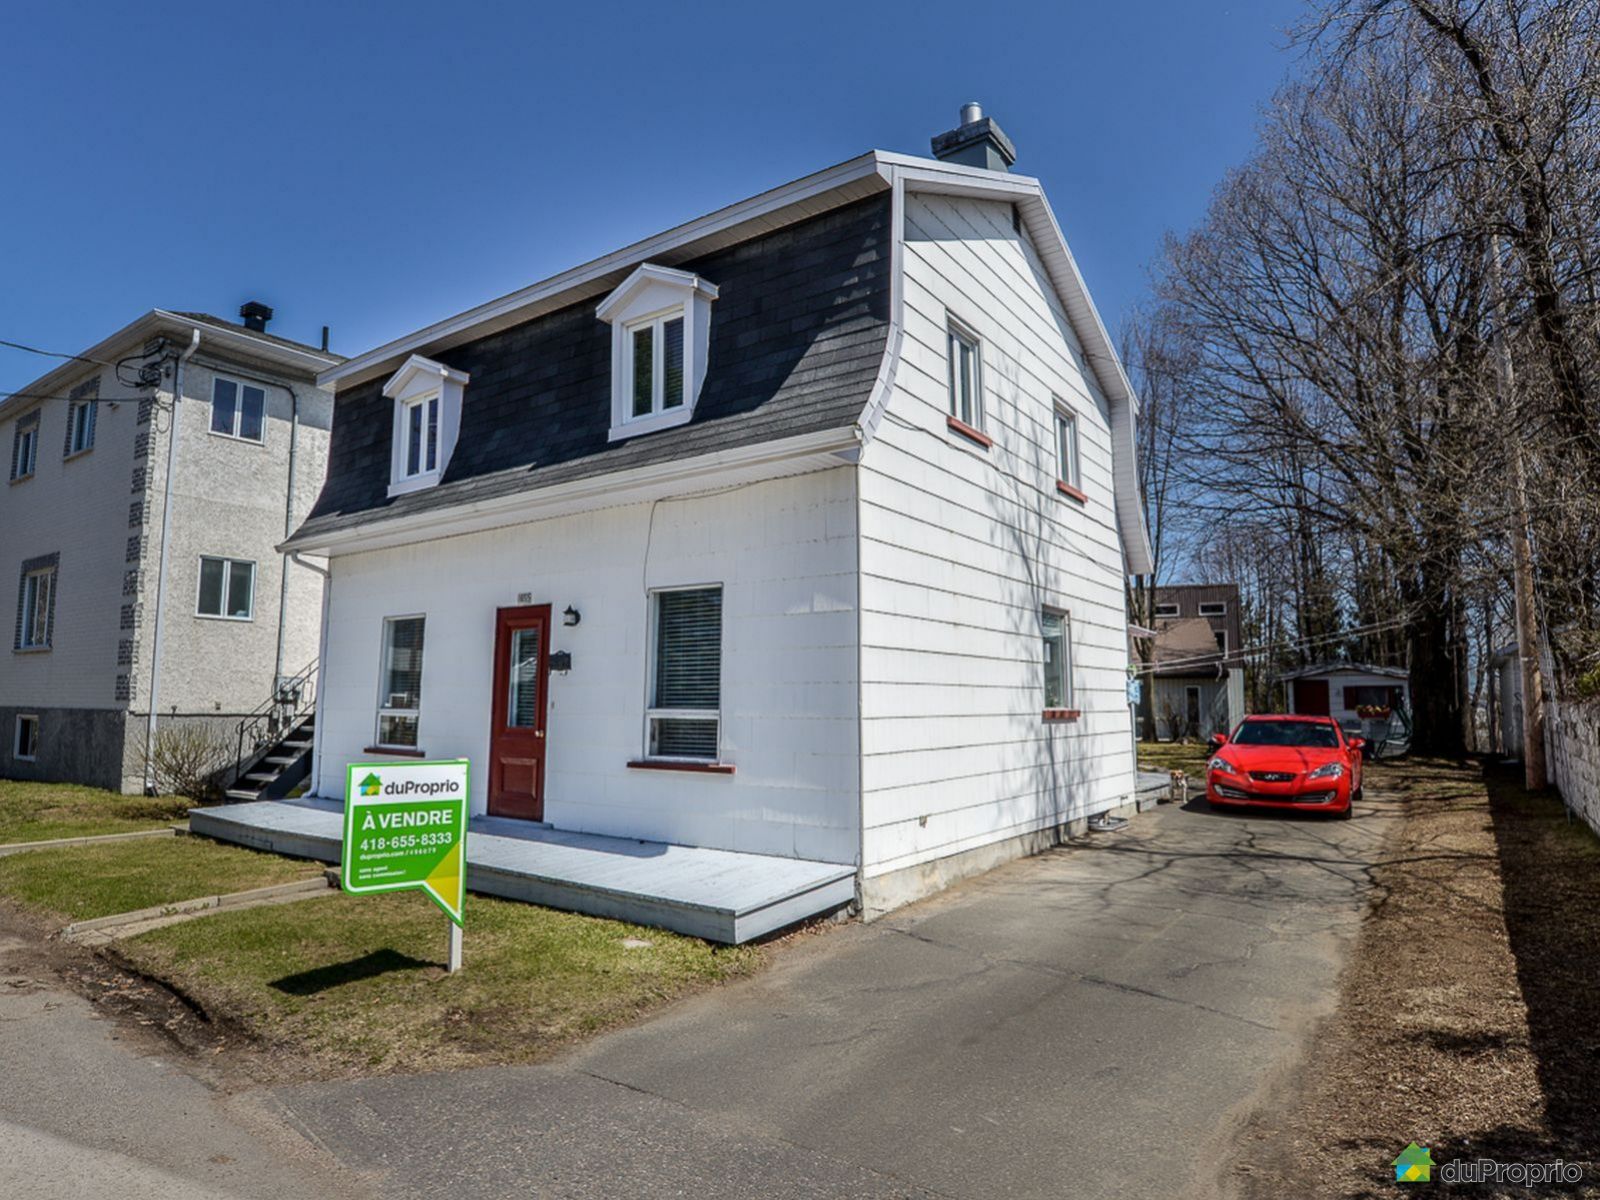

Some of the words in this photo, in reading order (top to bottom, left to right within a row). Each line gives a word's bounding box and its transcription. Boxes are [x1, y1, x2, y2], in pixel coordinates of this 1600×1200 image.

[384, 779, 459, 795] duProprio
[362, 811, 376, 830] À
[378, 809, 453, 829] VENDRE
